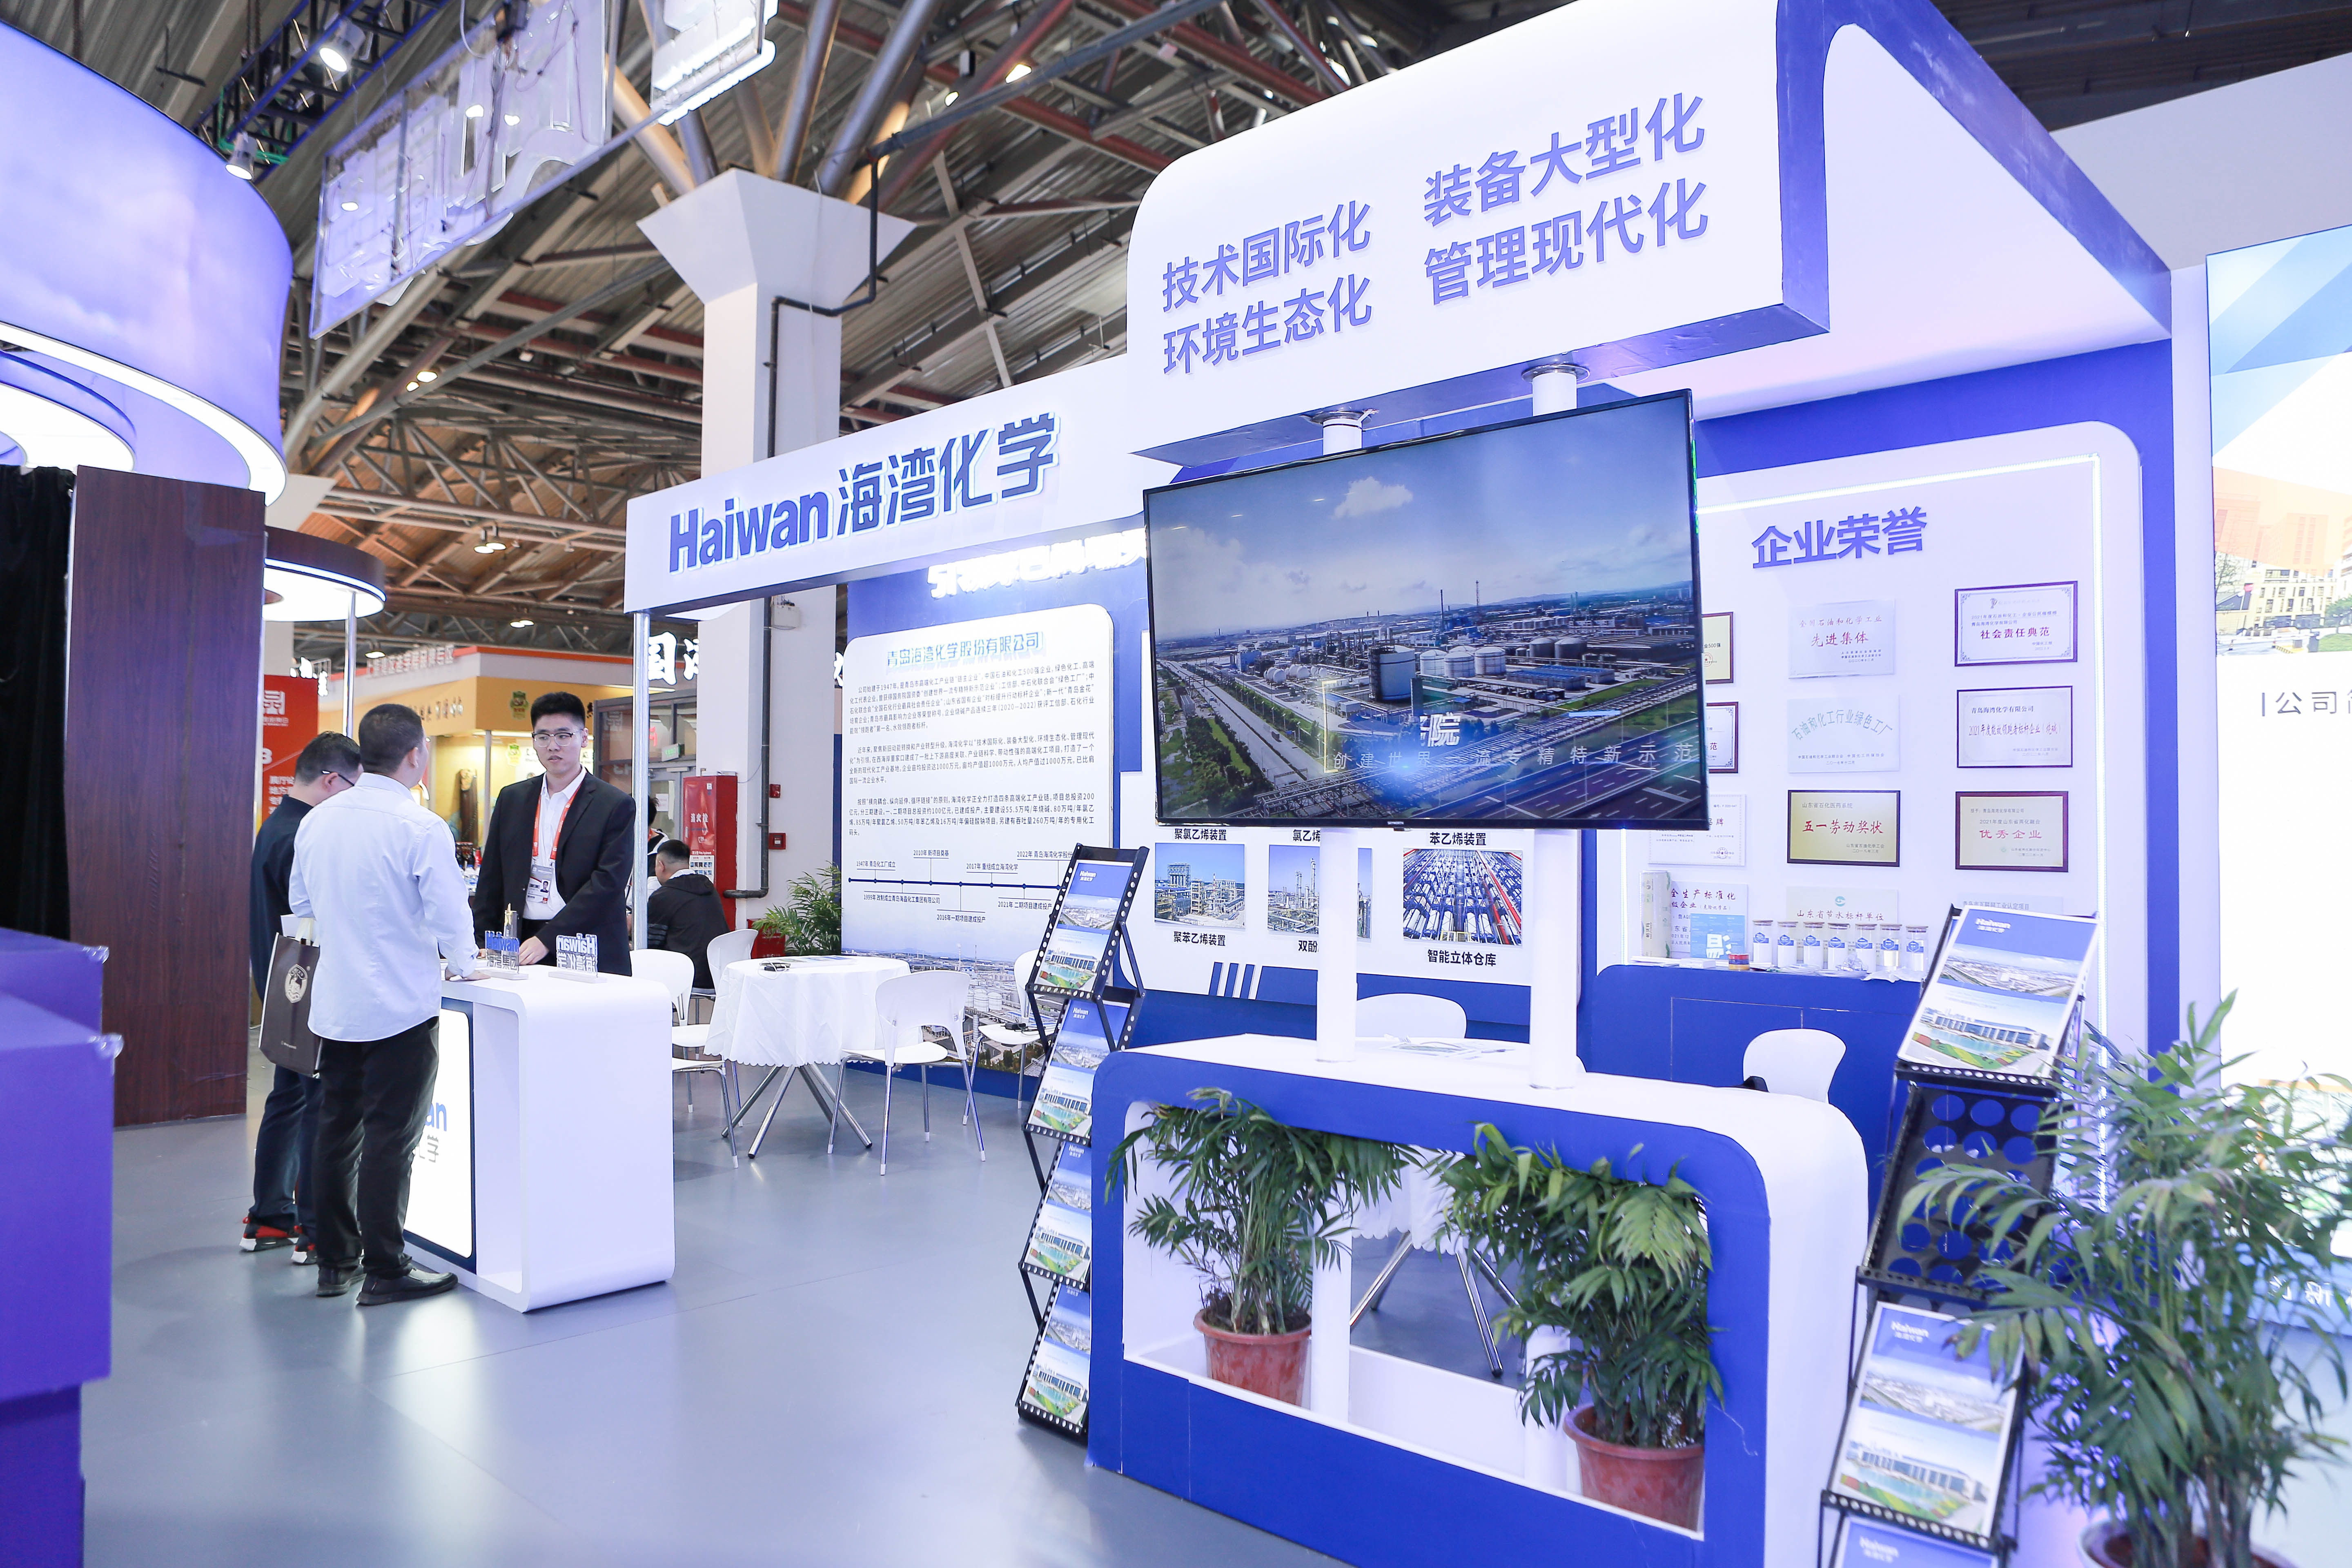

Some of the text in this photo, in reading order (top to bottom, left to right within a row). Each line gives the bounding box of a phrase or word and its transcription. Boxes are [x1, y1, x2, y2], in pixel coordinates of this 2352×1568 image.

[1424, 92, 1706, 227] 装备大型化
[1424, 178, 1709, 306] 管理现代化
[1163, 199, 1370, 312] 技术国际化
[1164, 273, 1372, 374] 环境生态化
[669, 490, 831, 573] Haiwan
[837, 412, 1058, 536] 海湾化学
[1752, 506, 1927, 570] 企业荣誉
[1799, 615, 1882, 628] 全国石油和化学工业
[1811, 631, 1869, 647] 先进集体
[1980, 627, 2050, 640] 社会责任典范
[888, 631, 1043, 666] 青岛海湾化学股份有限公司
[2275, 691, 2352, 715] 公司
[1791, 709, 1893, 741] 石油和化工行业绿色工厂
[1174, 828, 1227, 840] 聚氯乙烯装置
[1802, 819, 1884, 834] 五一劳动奖状
[1980, 830, 2042, 839] 优秀企业
[1430, 832, 1486, 845] 苯乙烯装置
[1014, 902, 1052, 910] 二期项目建成投产
[1797, 909, 1884, 921] 山东省节水标杆单位
[1976, 918, 2011, 929] Haiwan
[1173, 931, 1226, 946] 聚苯乙烯装置
[1298, 940, 1319, 953] 双酚
[1428, 949, 1496, 967] 智能立体仓库
[419, 1134, 439, 1163] 学
